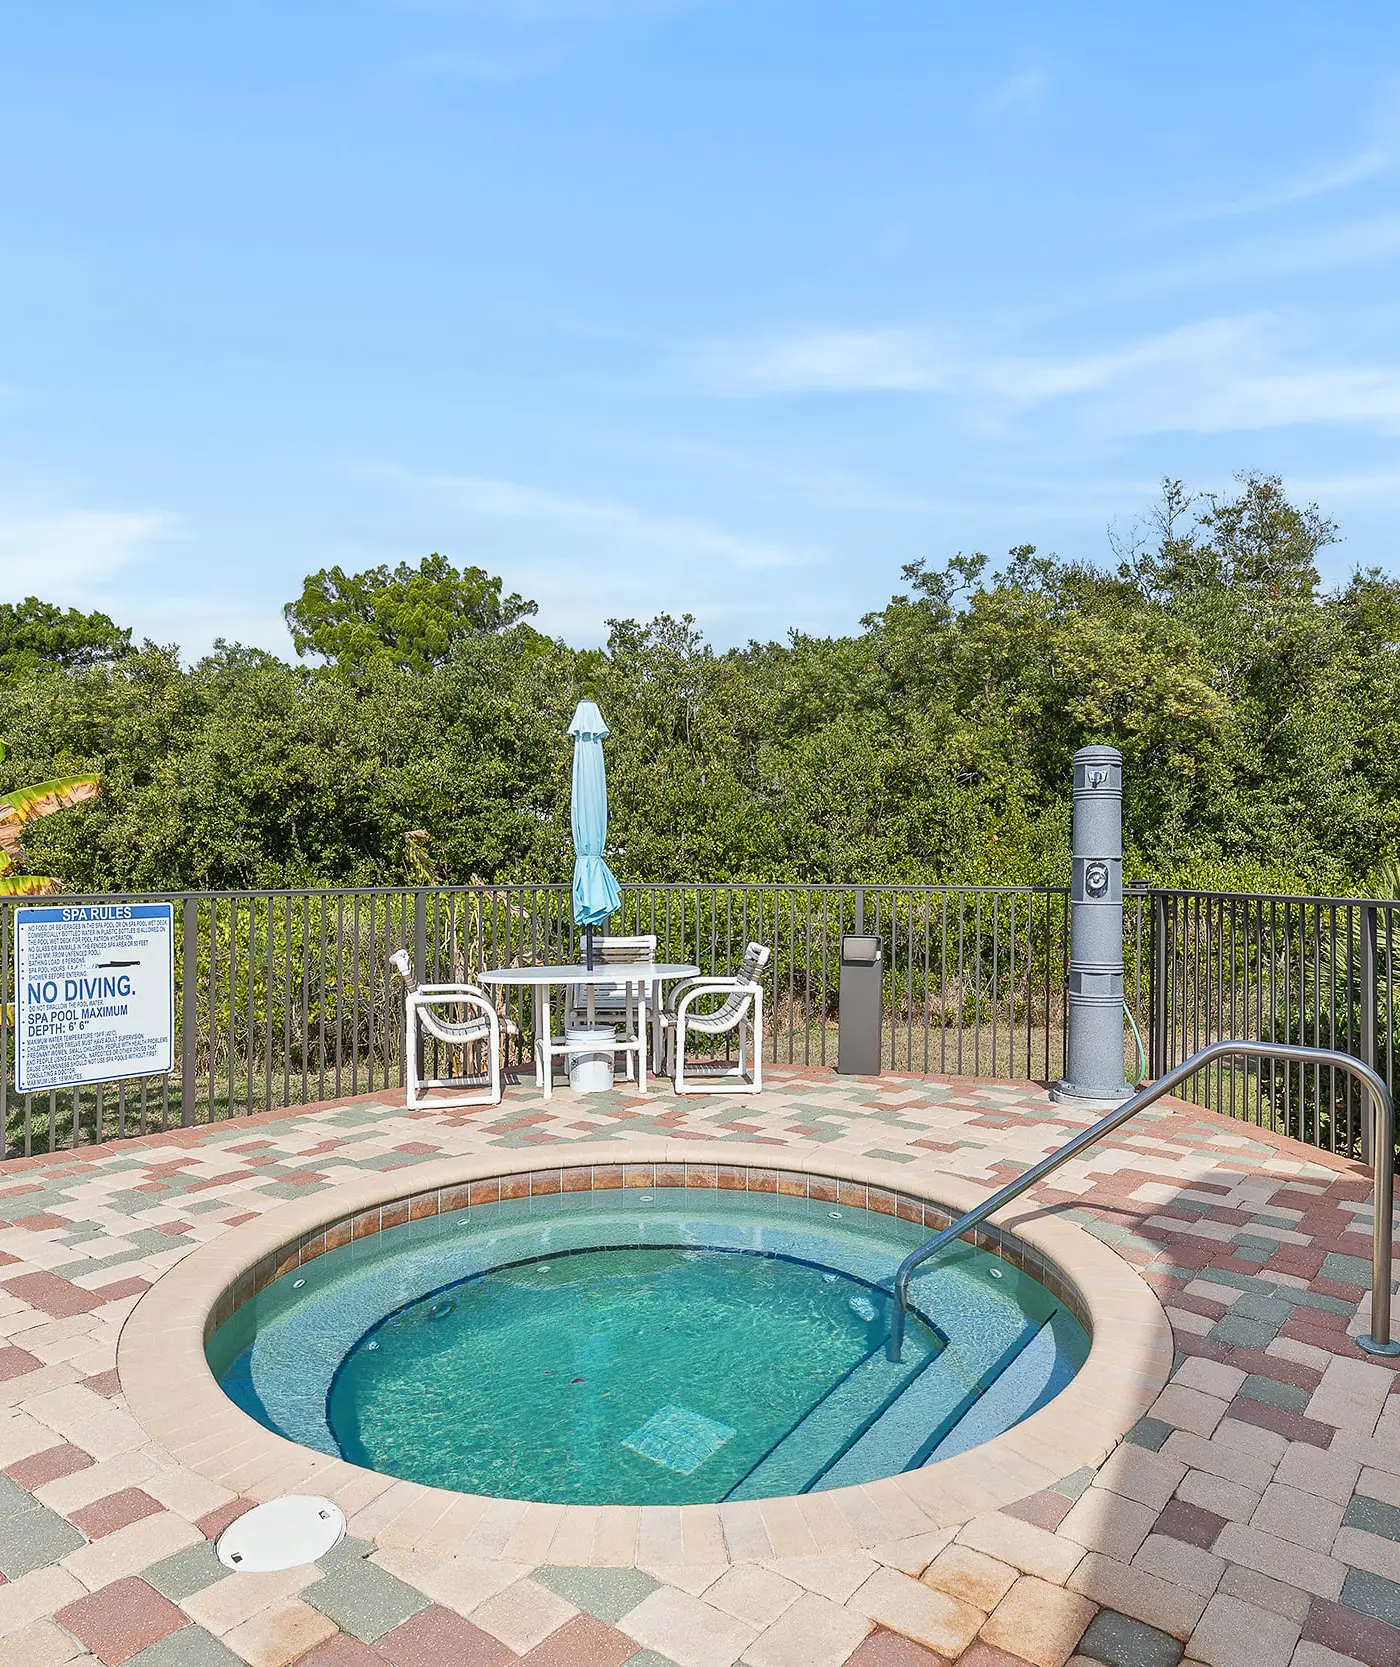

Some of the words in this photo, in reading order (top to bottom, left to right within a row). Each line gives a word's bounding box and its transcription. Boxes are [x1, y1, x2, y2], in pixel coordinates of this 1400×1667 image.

[62, 909, 87, 921] SPA
[90, 907, 131, 920] RULES
[28, 930, 60, 938] COMMERCIALLY
[65, 949, 86, 957] UNFENCED
[28, 973, 46, 981] SHOWER
[48, 971, 64, 979] BEFORE
[28, 980, 57, 1004] NO
[64, 974, 135, 1001] DIVING.
[46, 1002, 67, 1010] SWALLOW
[28, 1011, 47, 1024] SPA
[50, 1008, 78, 1022] POOL
[82, 1004, 127, 1019] MAXIMUM
[28, 1022, 65, 1037] DEPTH:
[26, 1043, 48, 1052] CHILDREN
[64, 1040, 80, 1048] TWELVE
[27, 1037, 46, 1046] MAXIMUM
[48, 1035, 62, 1043] WATER
[26, 1049, 50, 1059] PREGNANT
[69, 1046, 82, 1054] SMALL
[105, 1041, 120, 1050] PEOPLE
[132, 1038, 146, 1047] HEALTH
[26, 1058, 35, 1066] AND
[36, 1056, 52, 1065] PEOPLE
[54, 1054, 66, 1063] USING
[89, 1049, 111, 1058] NARCOTICS
[119, 1046, 132, 1055] OTHER
[133, 1045, 146, 1053] DRUGS
[26, 1064, 40, 1073] CAUSE
[42, 1061, 69, 1071] DROWSINESS
[70, 1058, 86, 1067] SHOULD
[114, 1054, 127, 1062] POOLS
[26, 1077, 47, 1086] MAXIMUM
